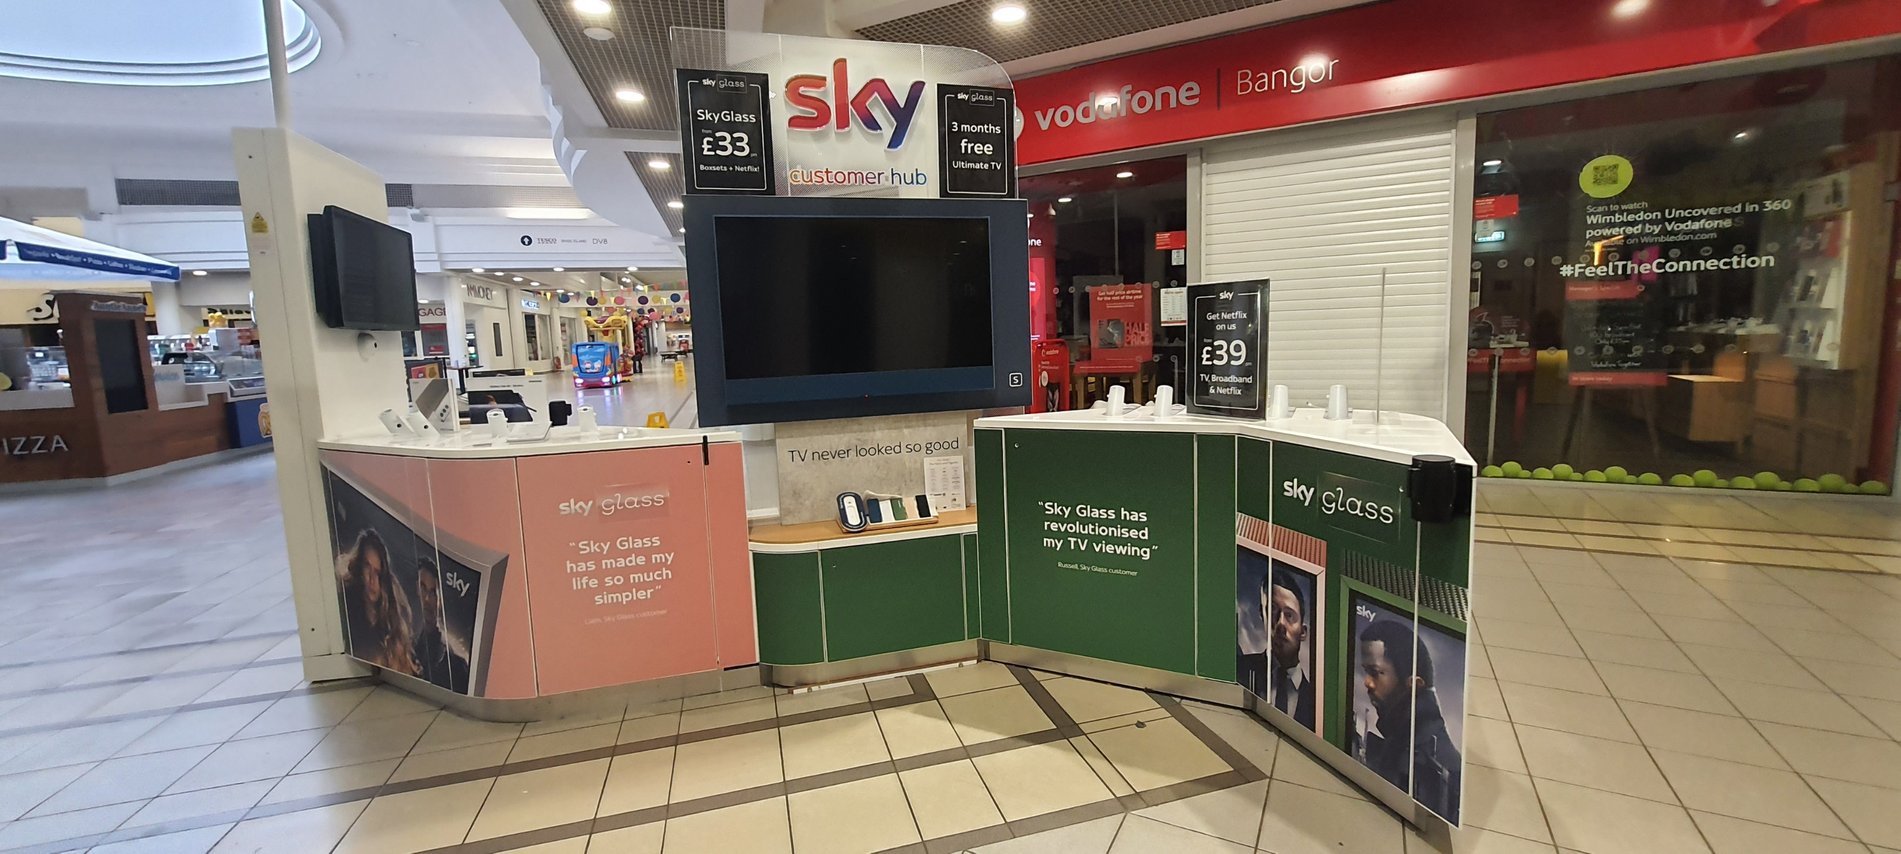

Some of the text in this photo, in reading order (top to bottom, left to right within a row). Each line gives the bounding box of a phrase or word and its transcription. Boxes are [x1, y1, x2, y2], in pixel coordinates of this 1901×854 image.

[702, 79, 745, 88] sky glass
[957, 92, 993, 102] sky glass
[1034, 57, 1340, 131] vodafone Bangor
[784, 57, 927, 151] sky
[697, 109, 757, 123] Sky Glass
[951, 121, 1001, 134] 3 months
[702, 131, 750, 157] £33
[960, 139, 993, 155] free
[735, 164, 760, 172] Netflix!
[952, 161, 1002, 170] Ultimate TV
[790, 167, 928, 186] customer hub
[1586, 201, 1648, 213] Scan to watch
[1586, 199, 1792, 225] Wimbledon Uncovered in 360
[1586, 217, 1733, 239] powered by Vodafone
[1640, 231, 1717, 243] Wimbledon.com
[1559, 253, 1775, 278] #FeelTheConnection
[1219, 291, 1234, 300] sky
[1206, 311, 1247, 320] Get Netflix
[1124, 322, 1150, 333] HALF
[1202, 339, 1247, 366] £39
[1211, 374, 1252, 383] Broadband
[1216, 386, 1242, 395] Netflix
[788, 437, 959, 463] TV never looked so good
[559, 493, 665, 516] sky glass
[1283, 478, 1394, 524] sky glass
[1075, 504, 1116, 519] Glass
[1121, 507, 1148, 522] has
[1044, 521, 1149, 540] revolutionised
[616, 536, 661, 551] Glass
[1043, 537, 1063, 551] my
[1068, 537, 1088, 551] TV
[566, 552, 674, 574] has made my
[1079, 564, 1091, 573] Sky
[1091, 565, 1108, 574] Glass
[1108, 567, 1138, 577] customer
[446, 572, 470, 597] sky
[572, 567, 672, 591] life so much
[1356, 604, 1377, 622] sky
